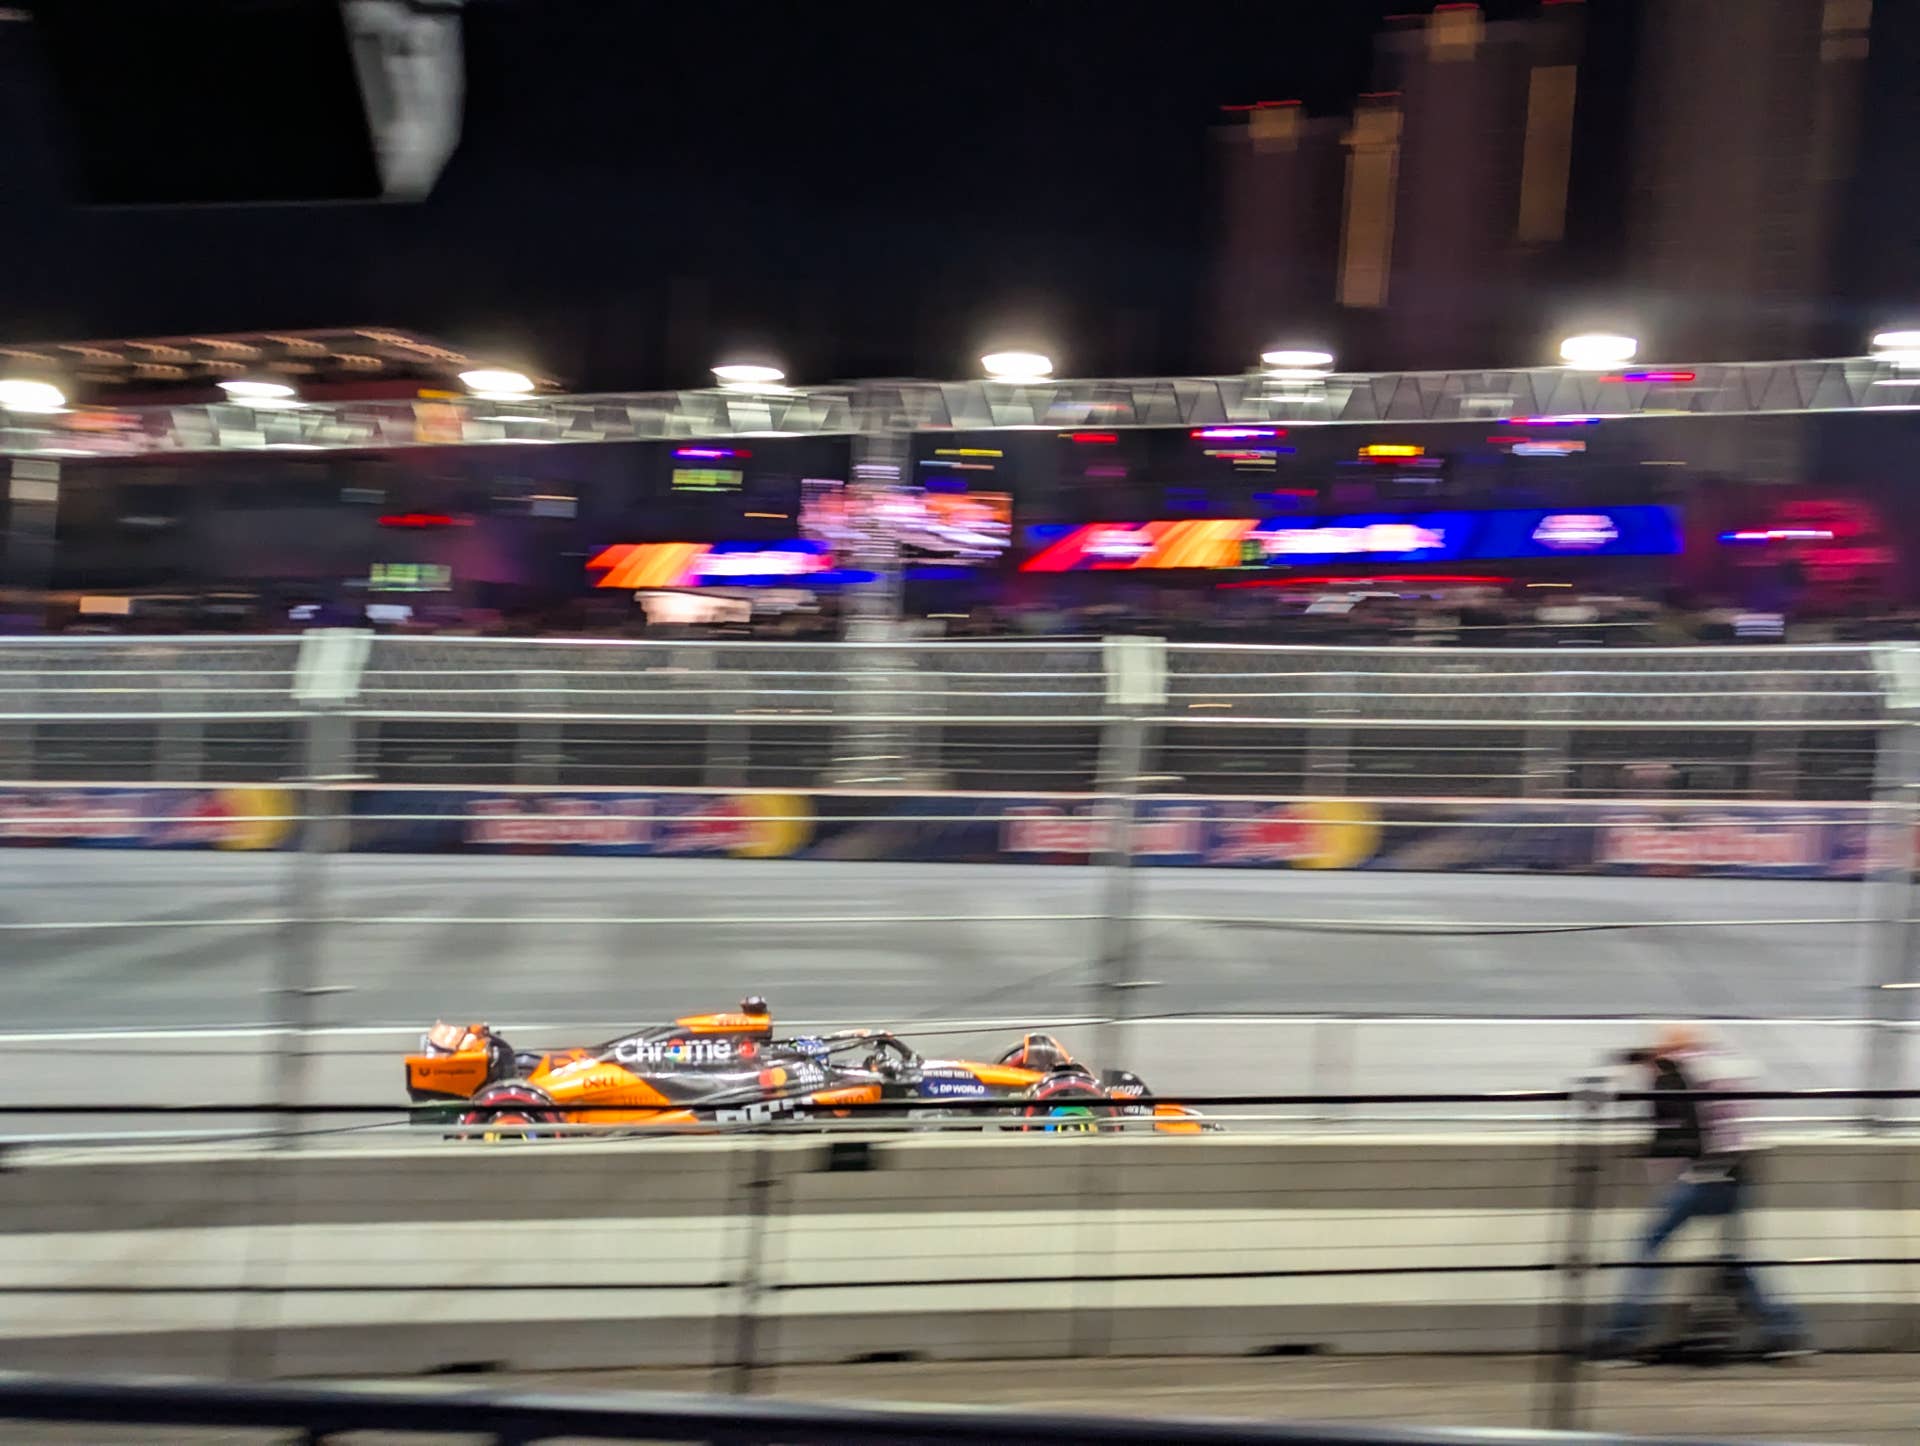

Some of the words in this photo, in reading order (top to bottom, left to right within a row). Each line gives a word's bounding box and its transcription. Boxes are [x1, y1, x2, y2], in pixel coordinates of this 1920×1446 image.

[615, 1038, 731, 1063] Chrome
[940, 1083, 952, 1094] DP
[953, 1084, 985, 1095] WORLD
